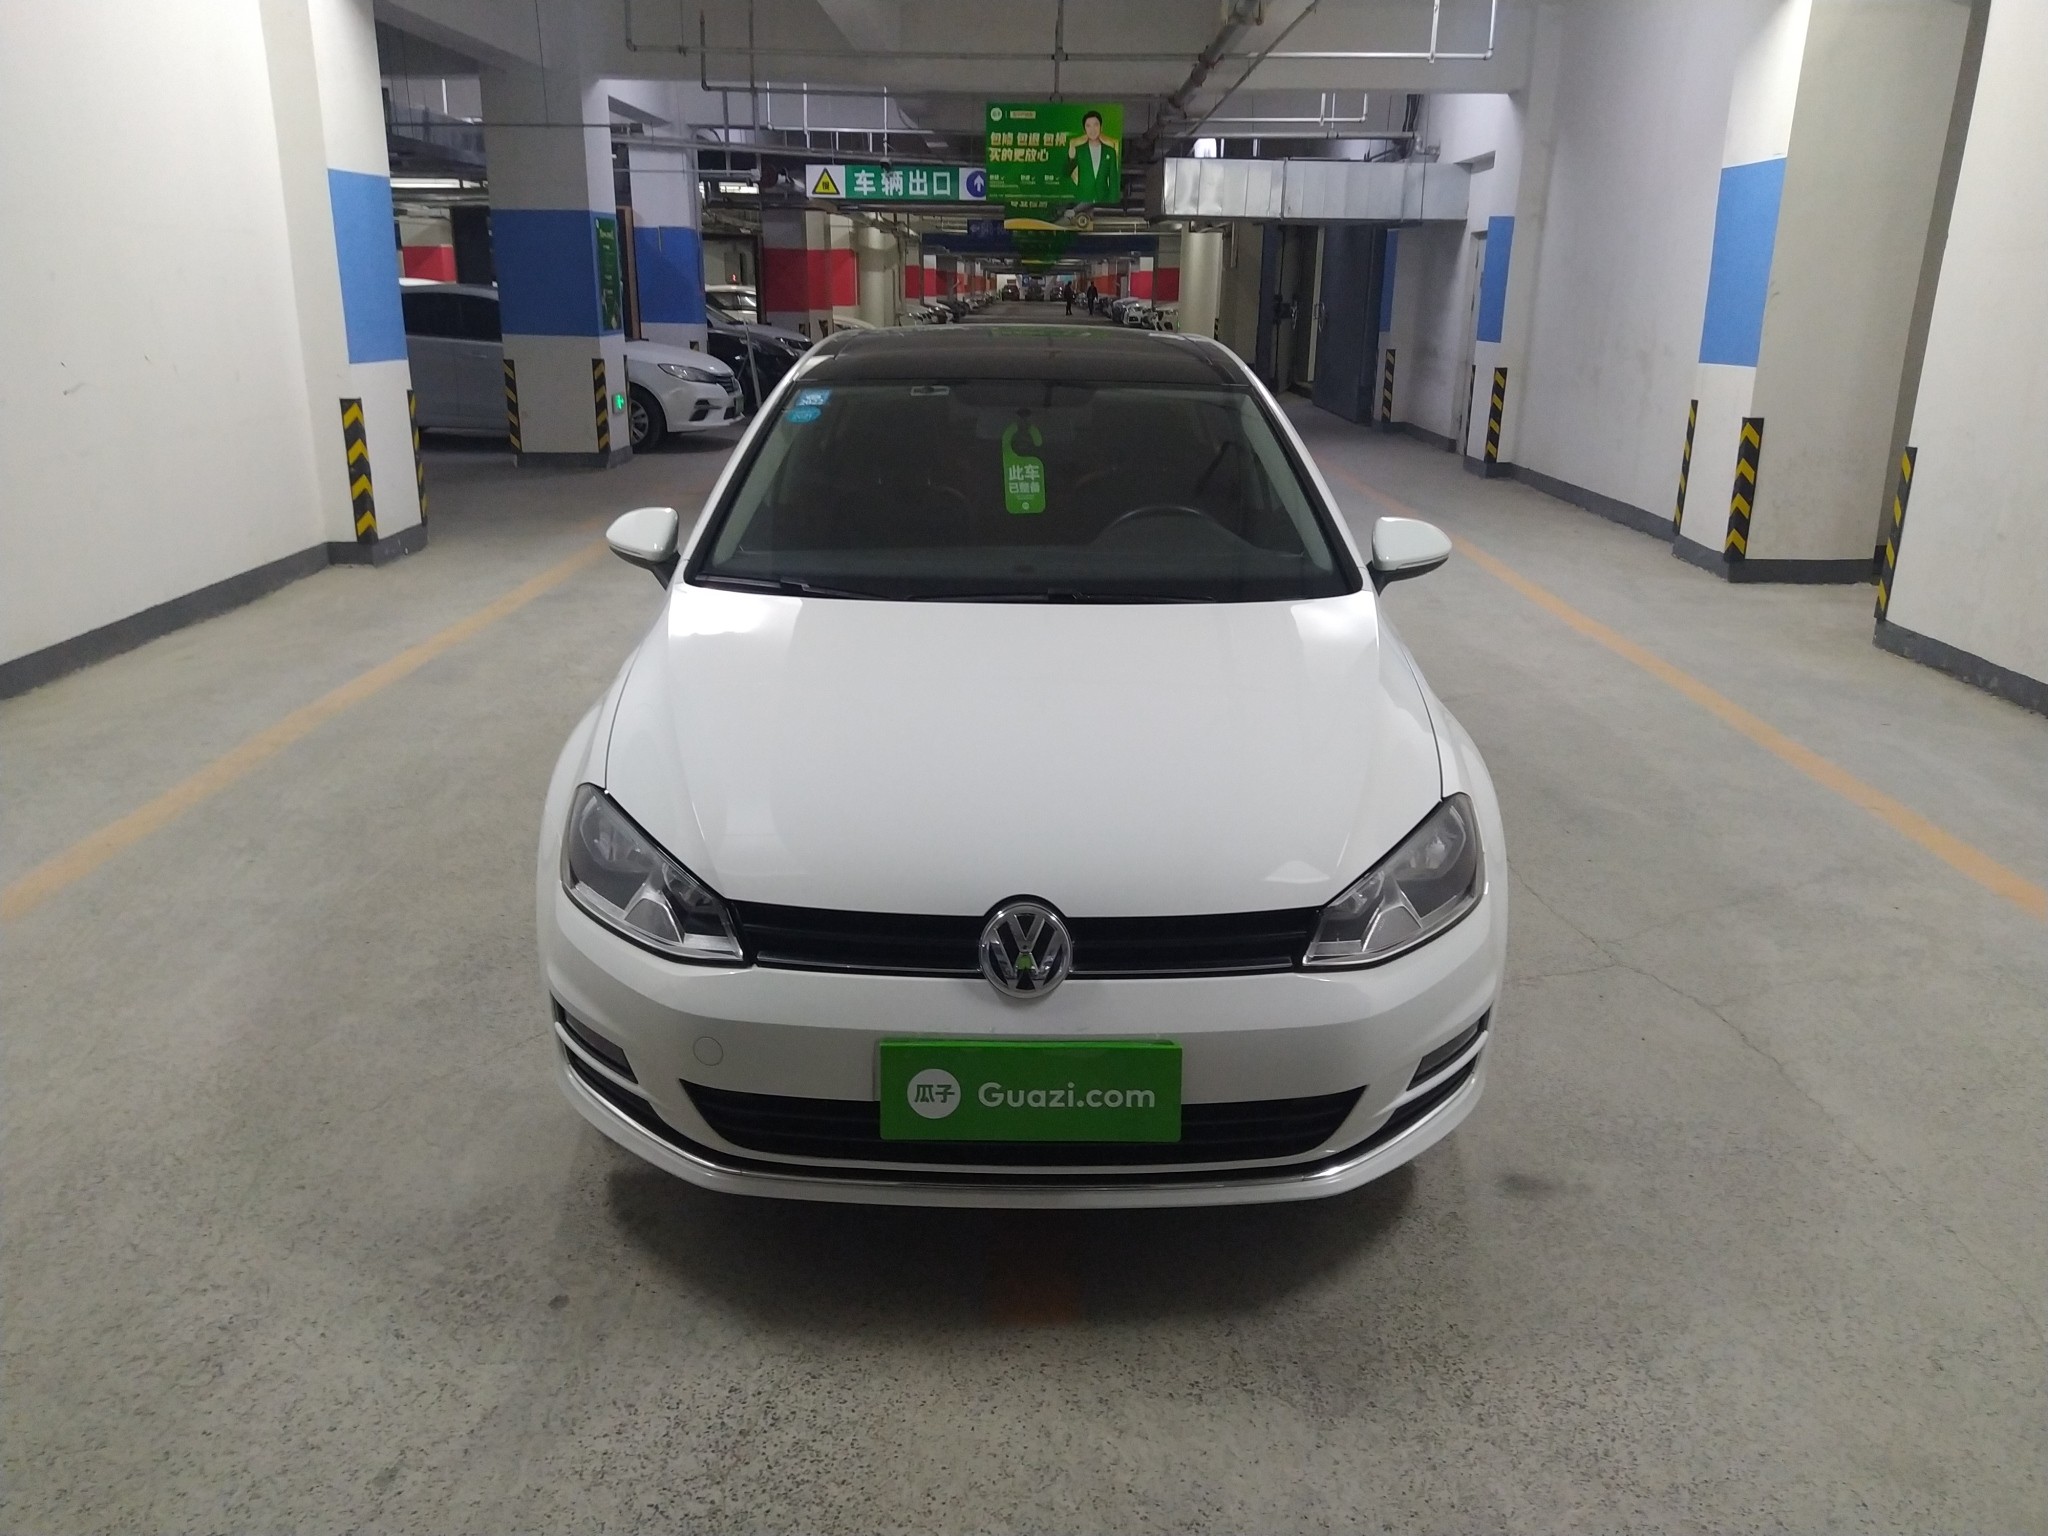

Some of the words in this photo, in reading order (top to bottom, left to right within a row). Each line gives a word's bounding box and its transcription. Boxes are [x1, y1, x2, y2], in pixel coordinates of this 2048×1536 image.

[989, 147, 1049, 162] 买的更放心
[853, 169, 951, 197] 车辆出口
[1008, 463, 1041, 481] 此车
[914, 1084, 955, 1104] 瓜子
[977, 1081, 1156, 1108] Guazi.com
